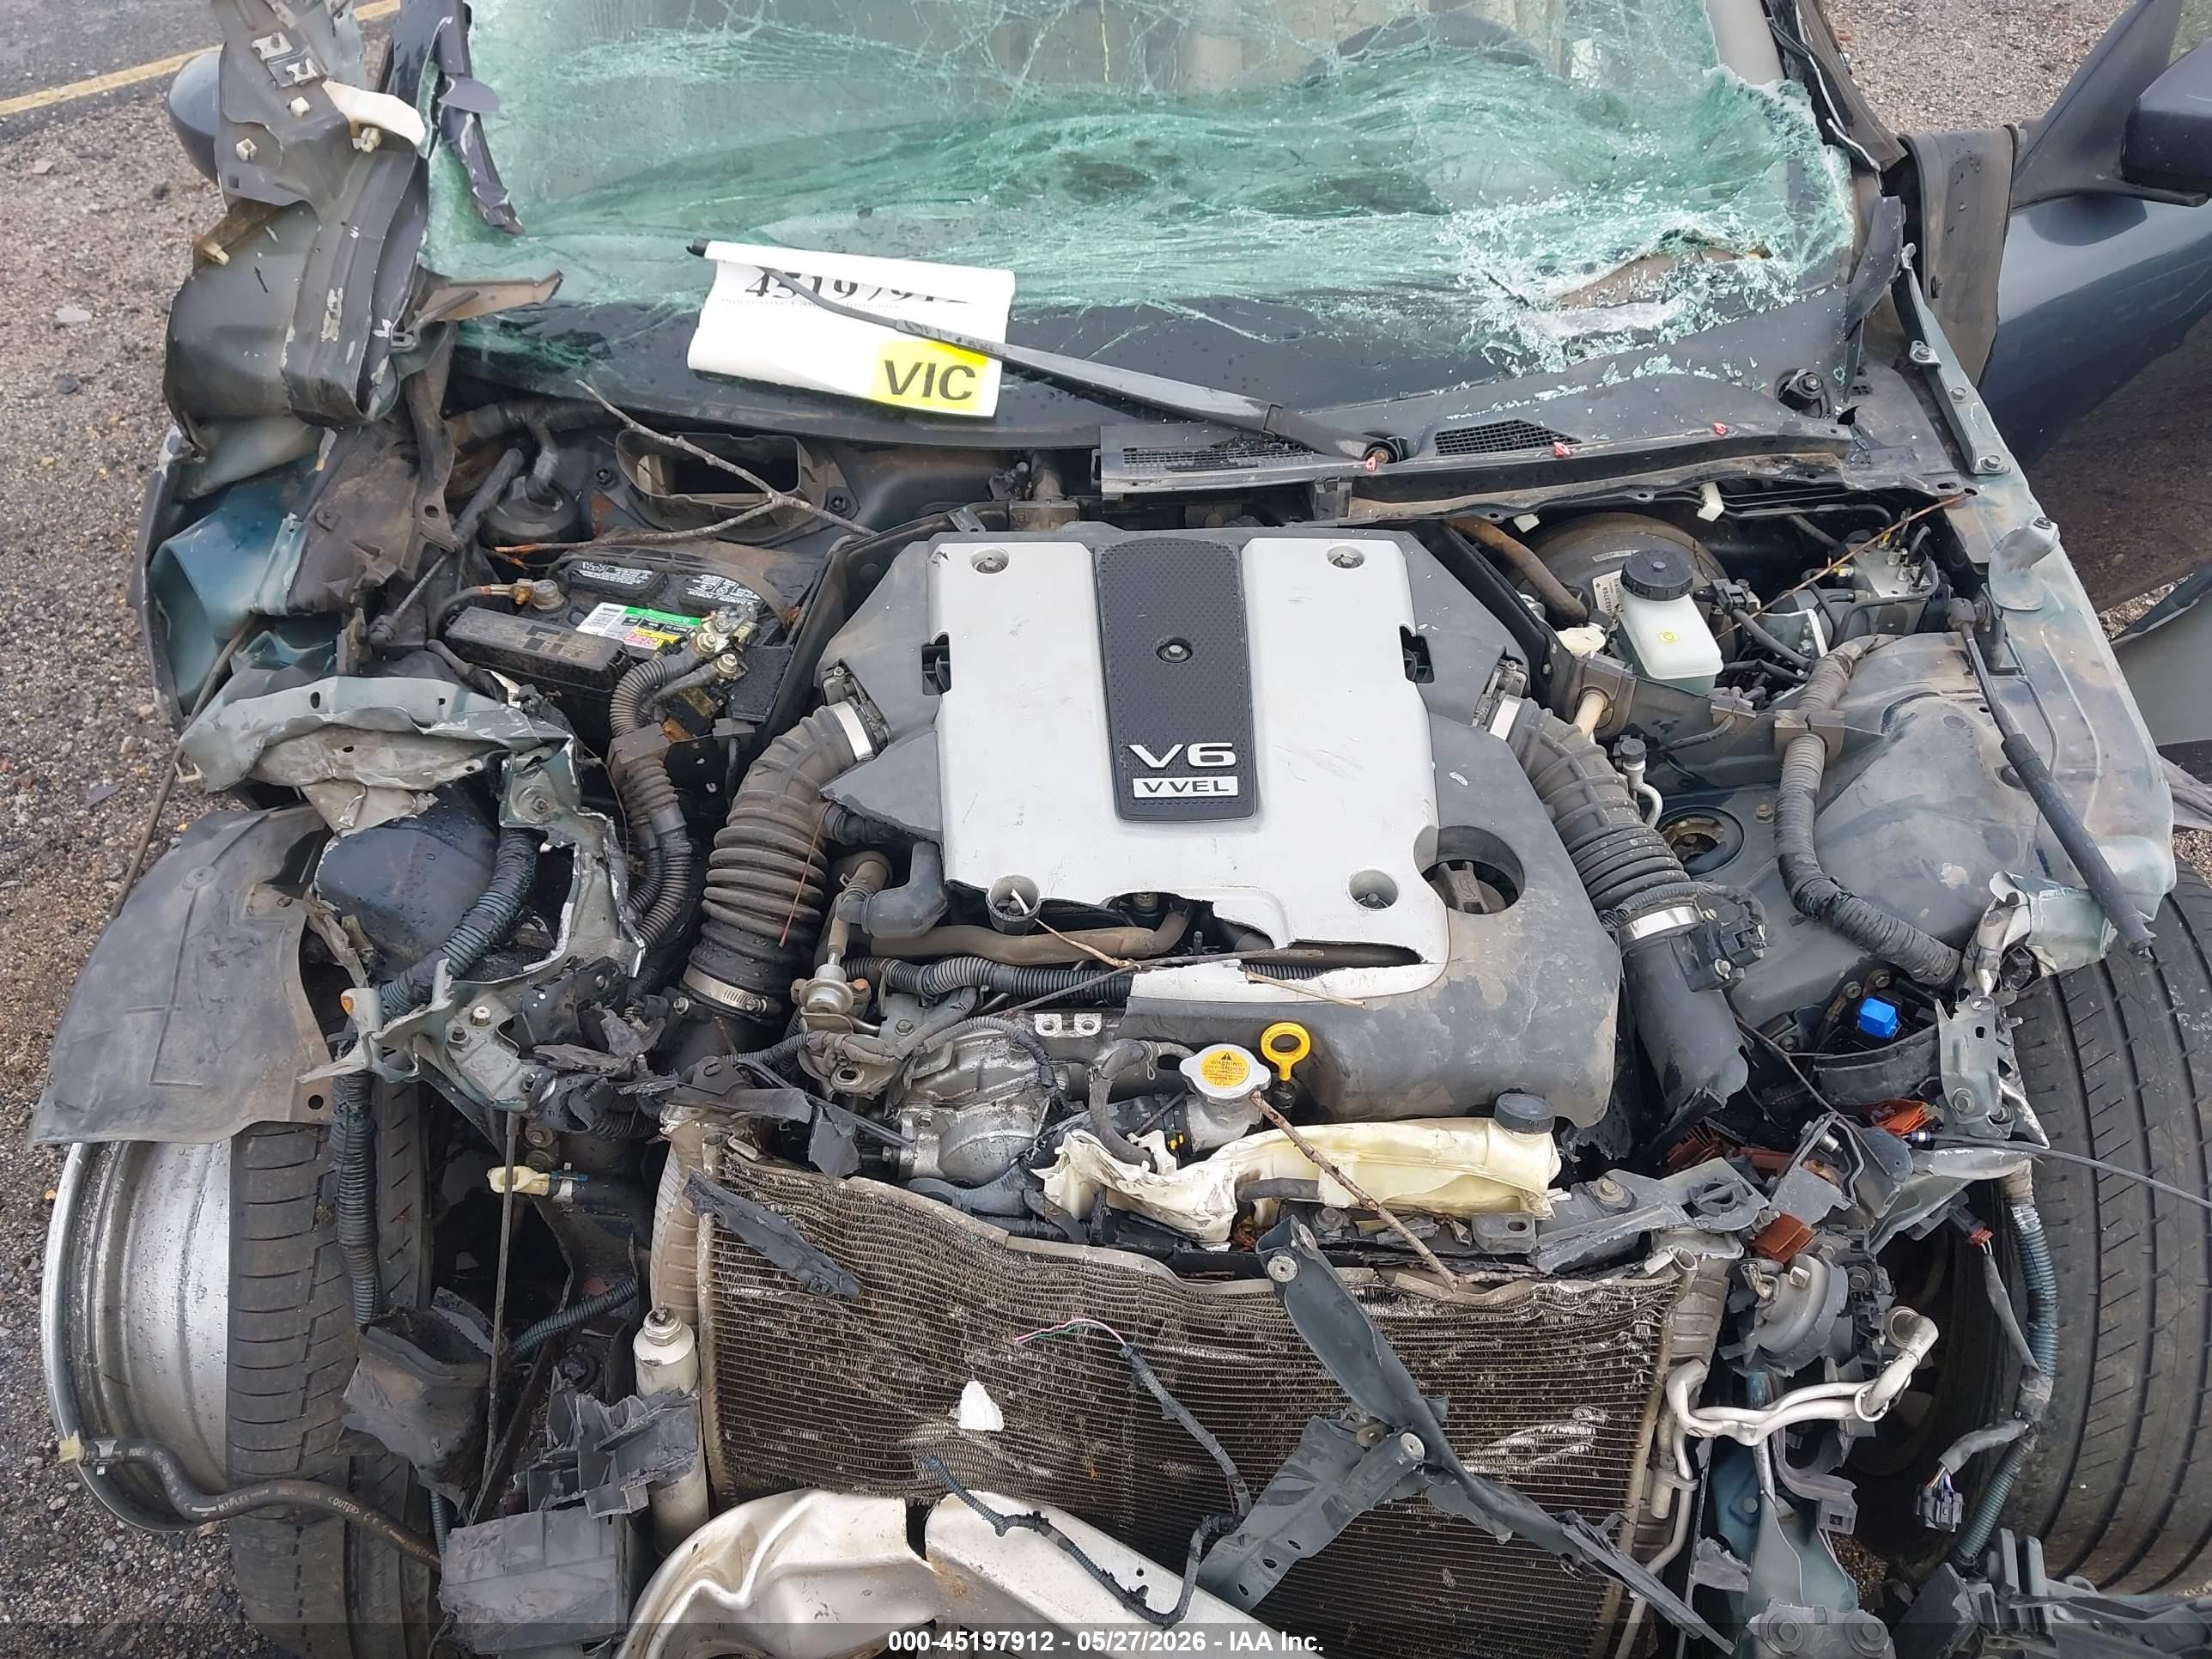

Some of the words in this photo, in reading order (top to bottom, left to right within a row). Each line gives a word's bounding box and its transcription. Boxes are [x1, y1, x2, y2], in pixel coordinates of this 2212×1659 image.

[884, 359, 976, 402] VIC
[1128, 742, 1237, 769] V6
[1143, 780, 1230, 793] VVEL
